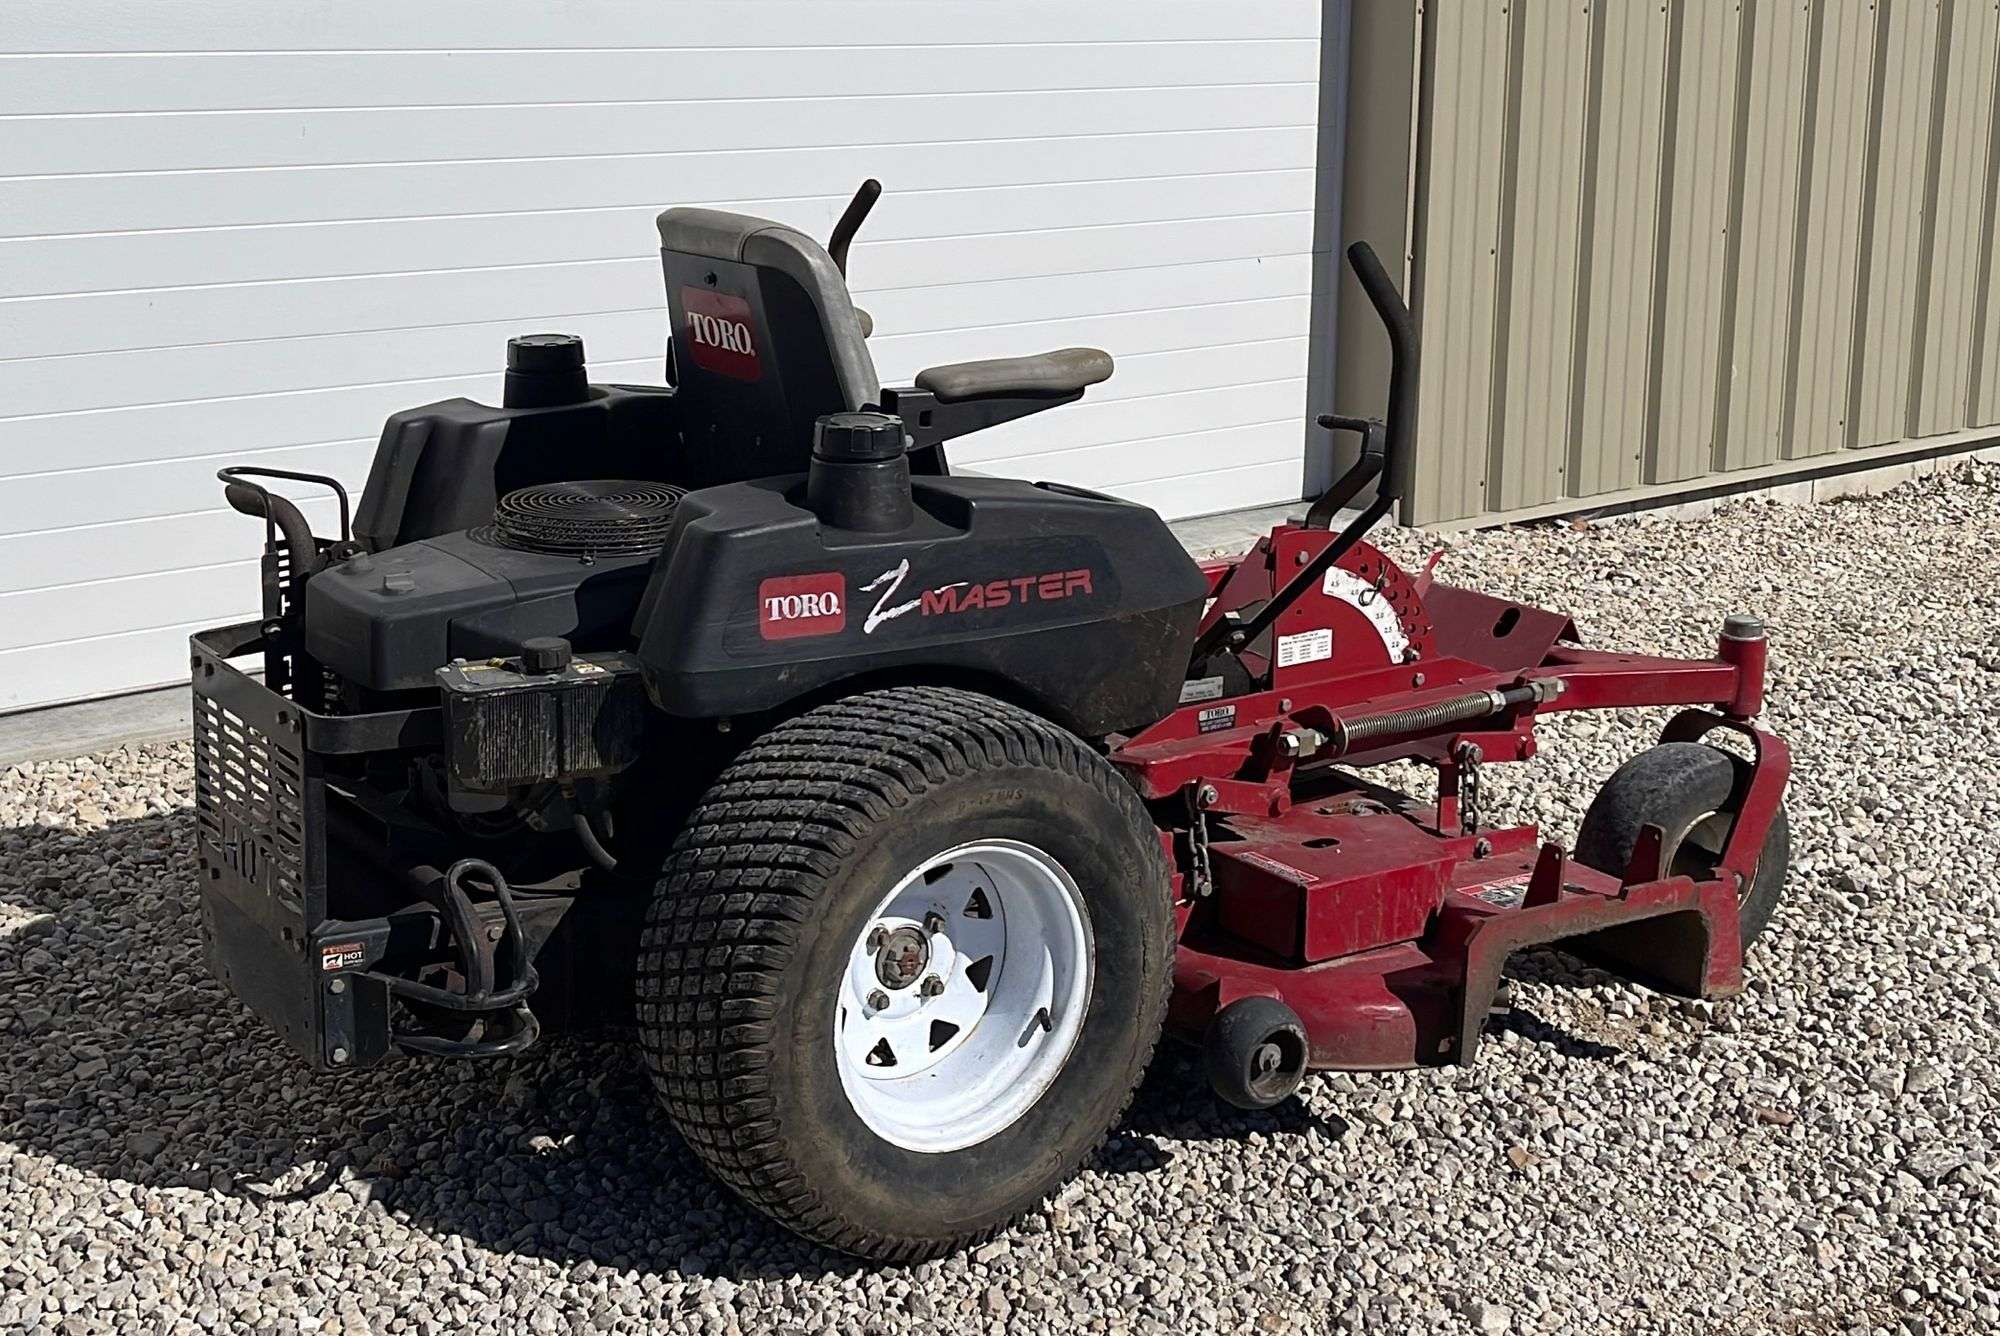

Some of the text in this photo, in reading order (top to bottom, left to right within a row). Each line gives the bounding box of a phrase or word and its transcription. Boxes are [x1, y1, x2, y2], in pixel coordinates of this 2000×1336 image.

[687, 311, 753, 355] TORO
[765, 558, 1093, 635] TORO Z MASTER
[343, 951, 363, 960] HOT
